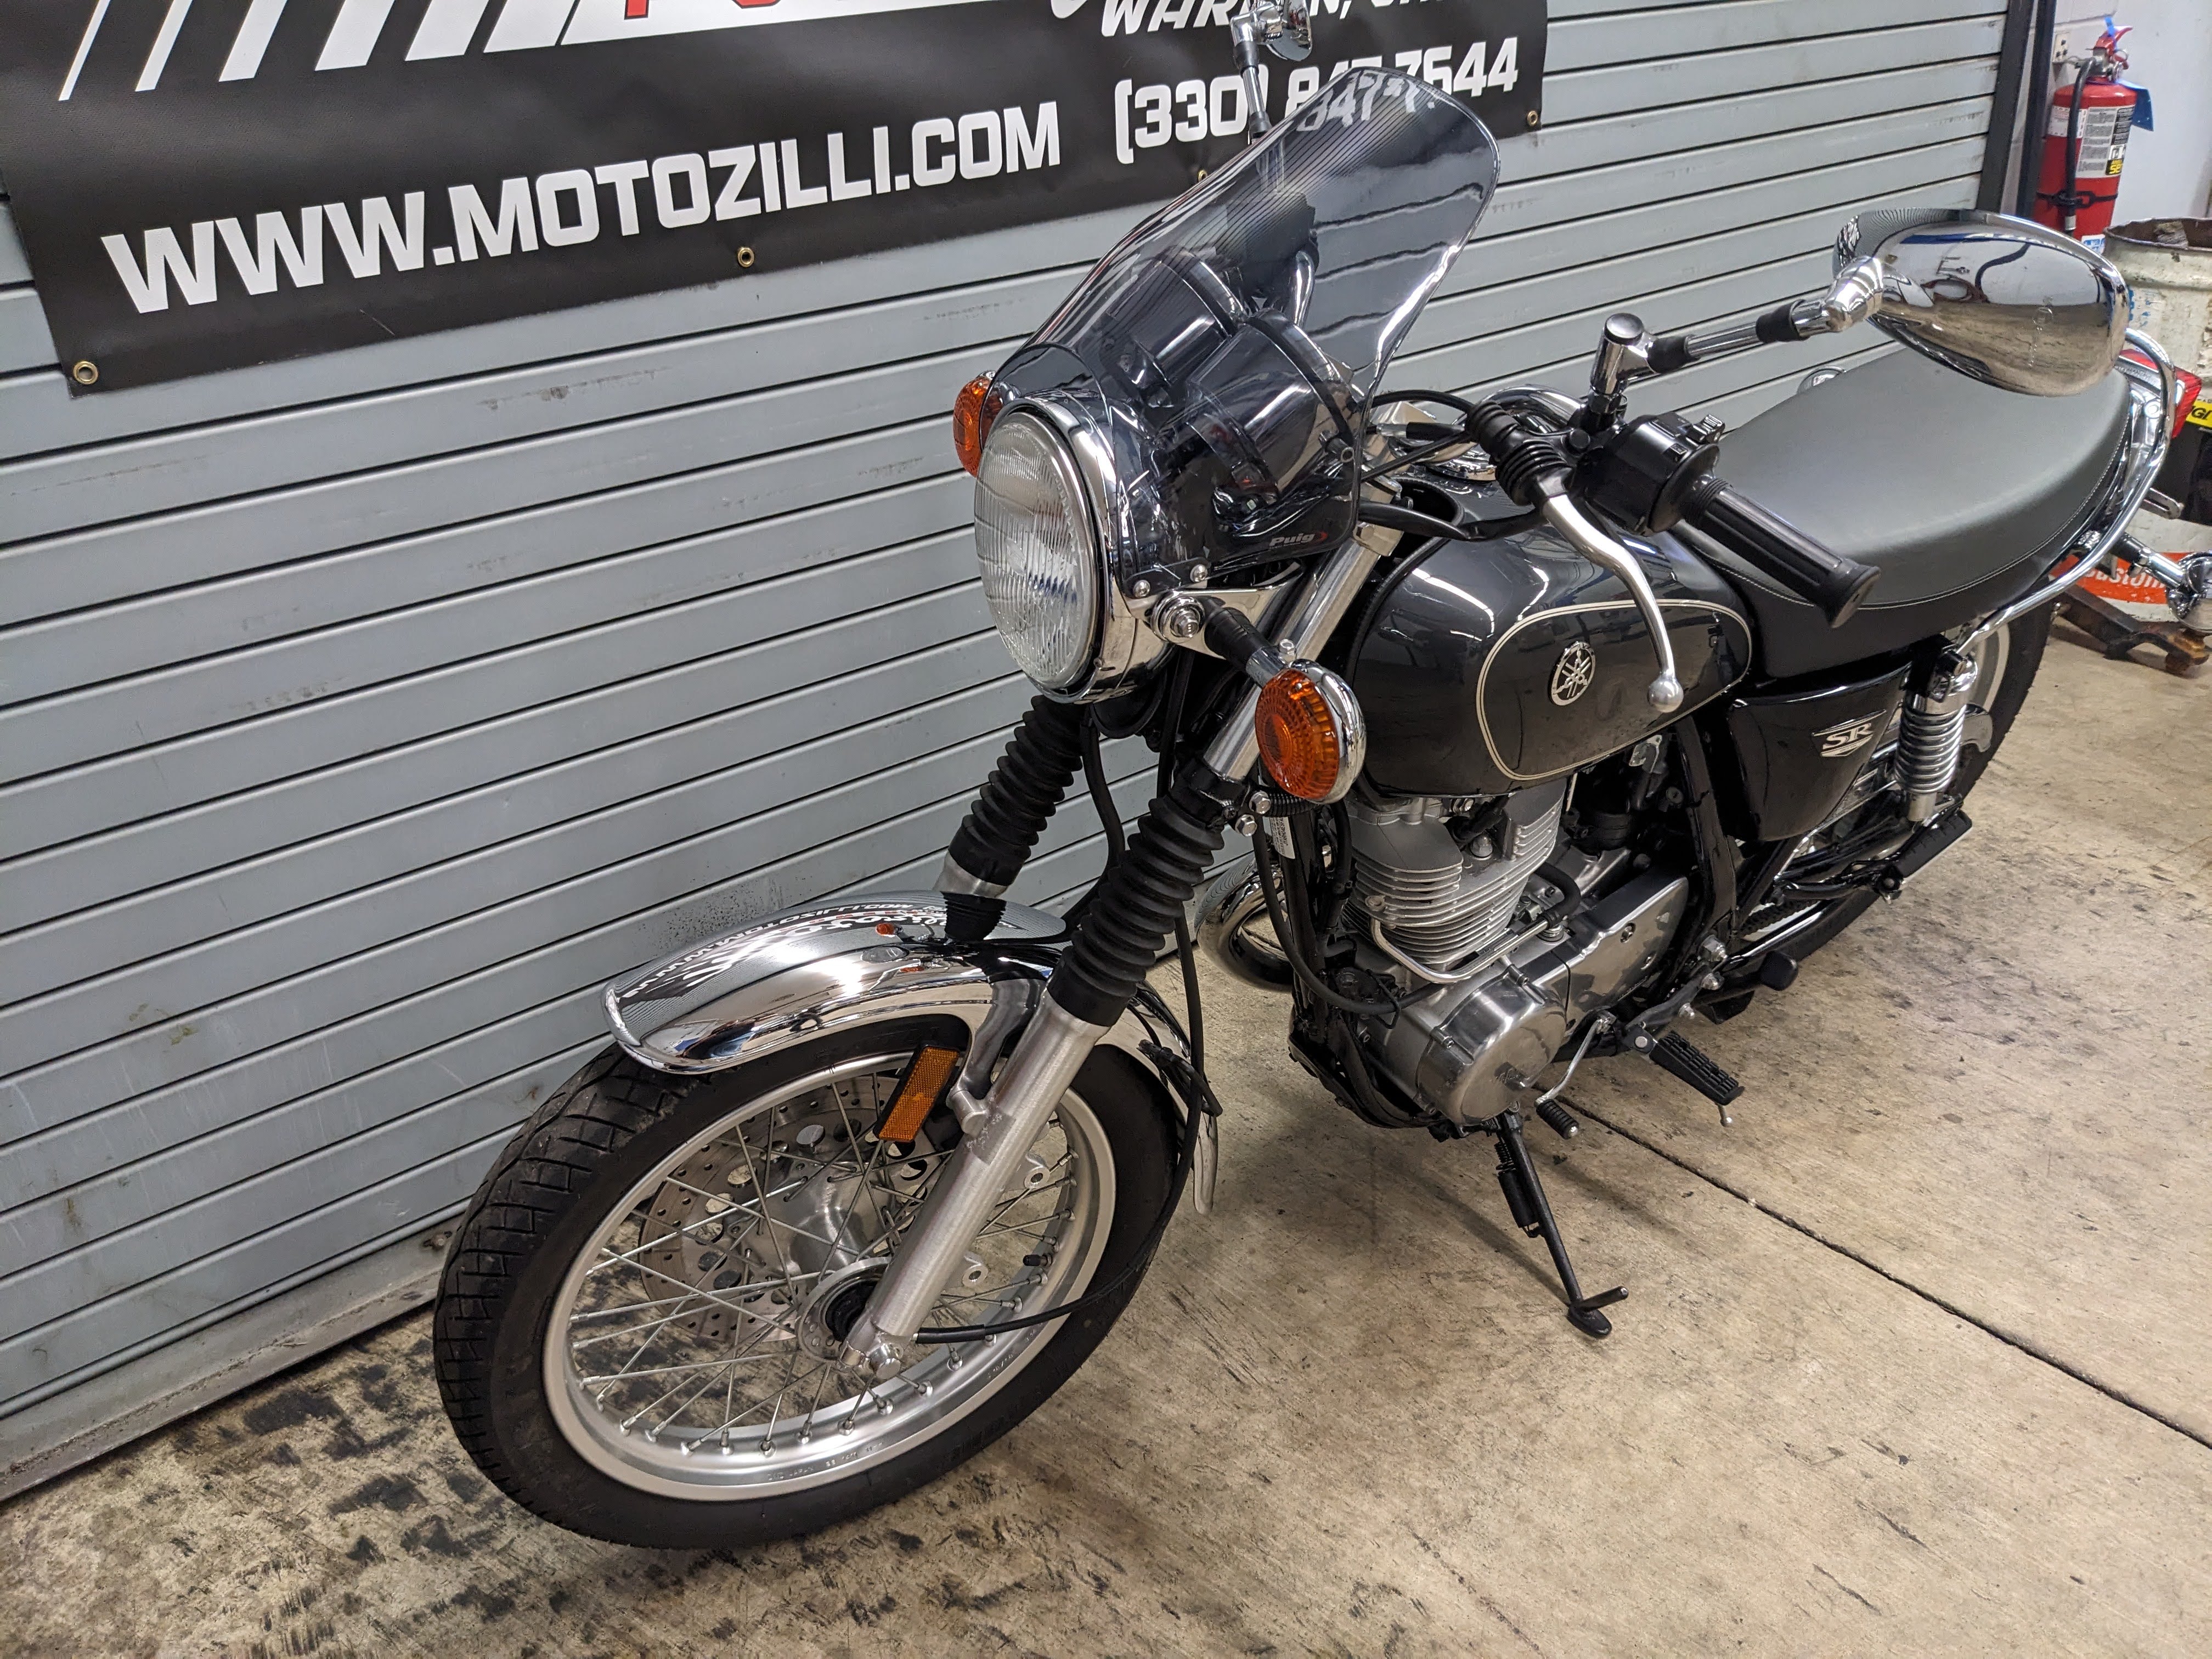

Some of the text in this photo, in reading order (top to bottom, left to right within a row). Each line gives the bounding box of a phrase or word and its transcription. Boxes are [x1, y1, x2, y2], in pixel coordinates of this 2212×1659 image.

[100, 101, 1060, 313] WWW.MOTOZILLI.COM
[1269, 533, 1315, 547] Puig
[1822, 723, 1874, 749] SR
